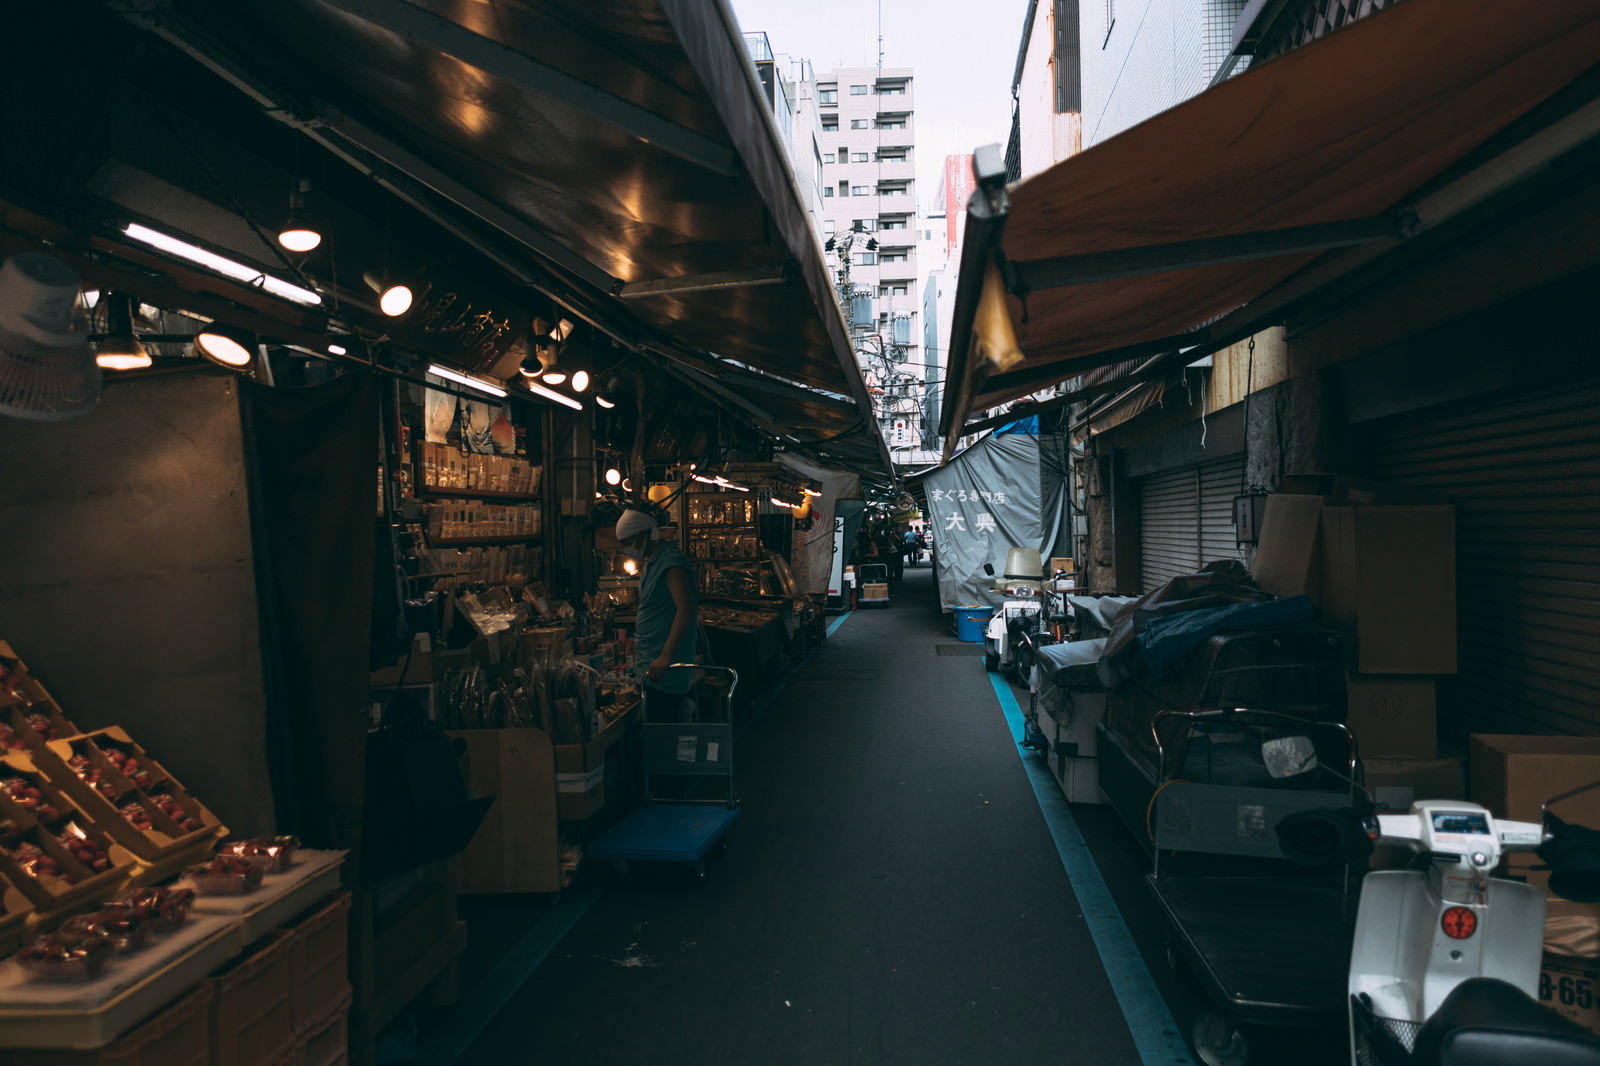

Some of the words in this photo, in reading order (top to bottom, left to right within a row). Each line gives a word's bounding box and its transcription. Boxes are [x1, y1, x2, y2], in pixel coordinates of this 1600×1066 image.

[931, 488, 1005, 505] まぐろ専門店
